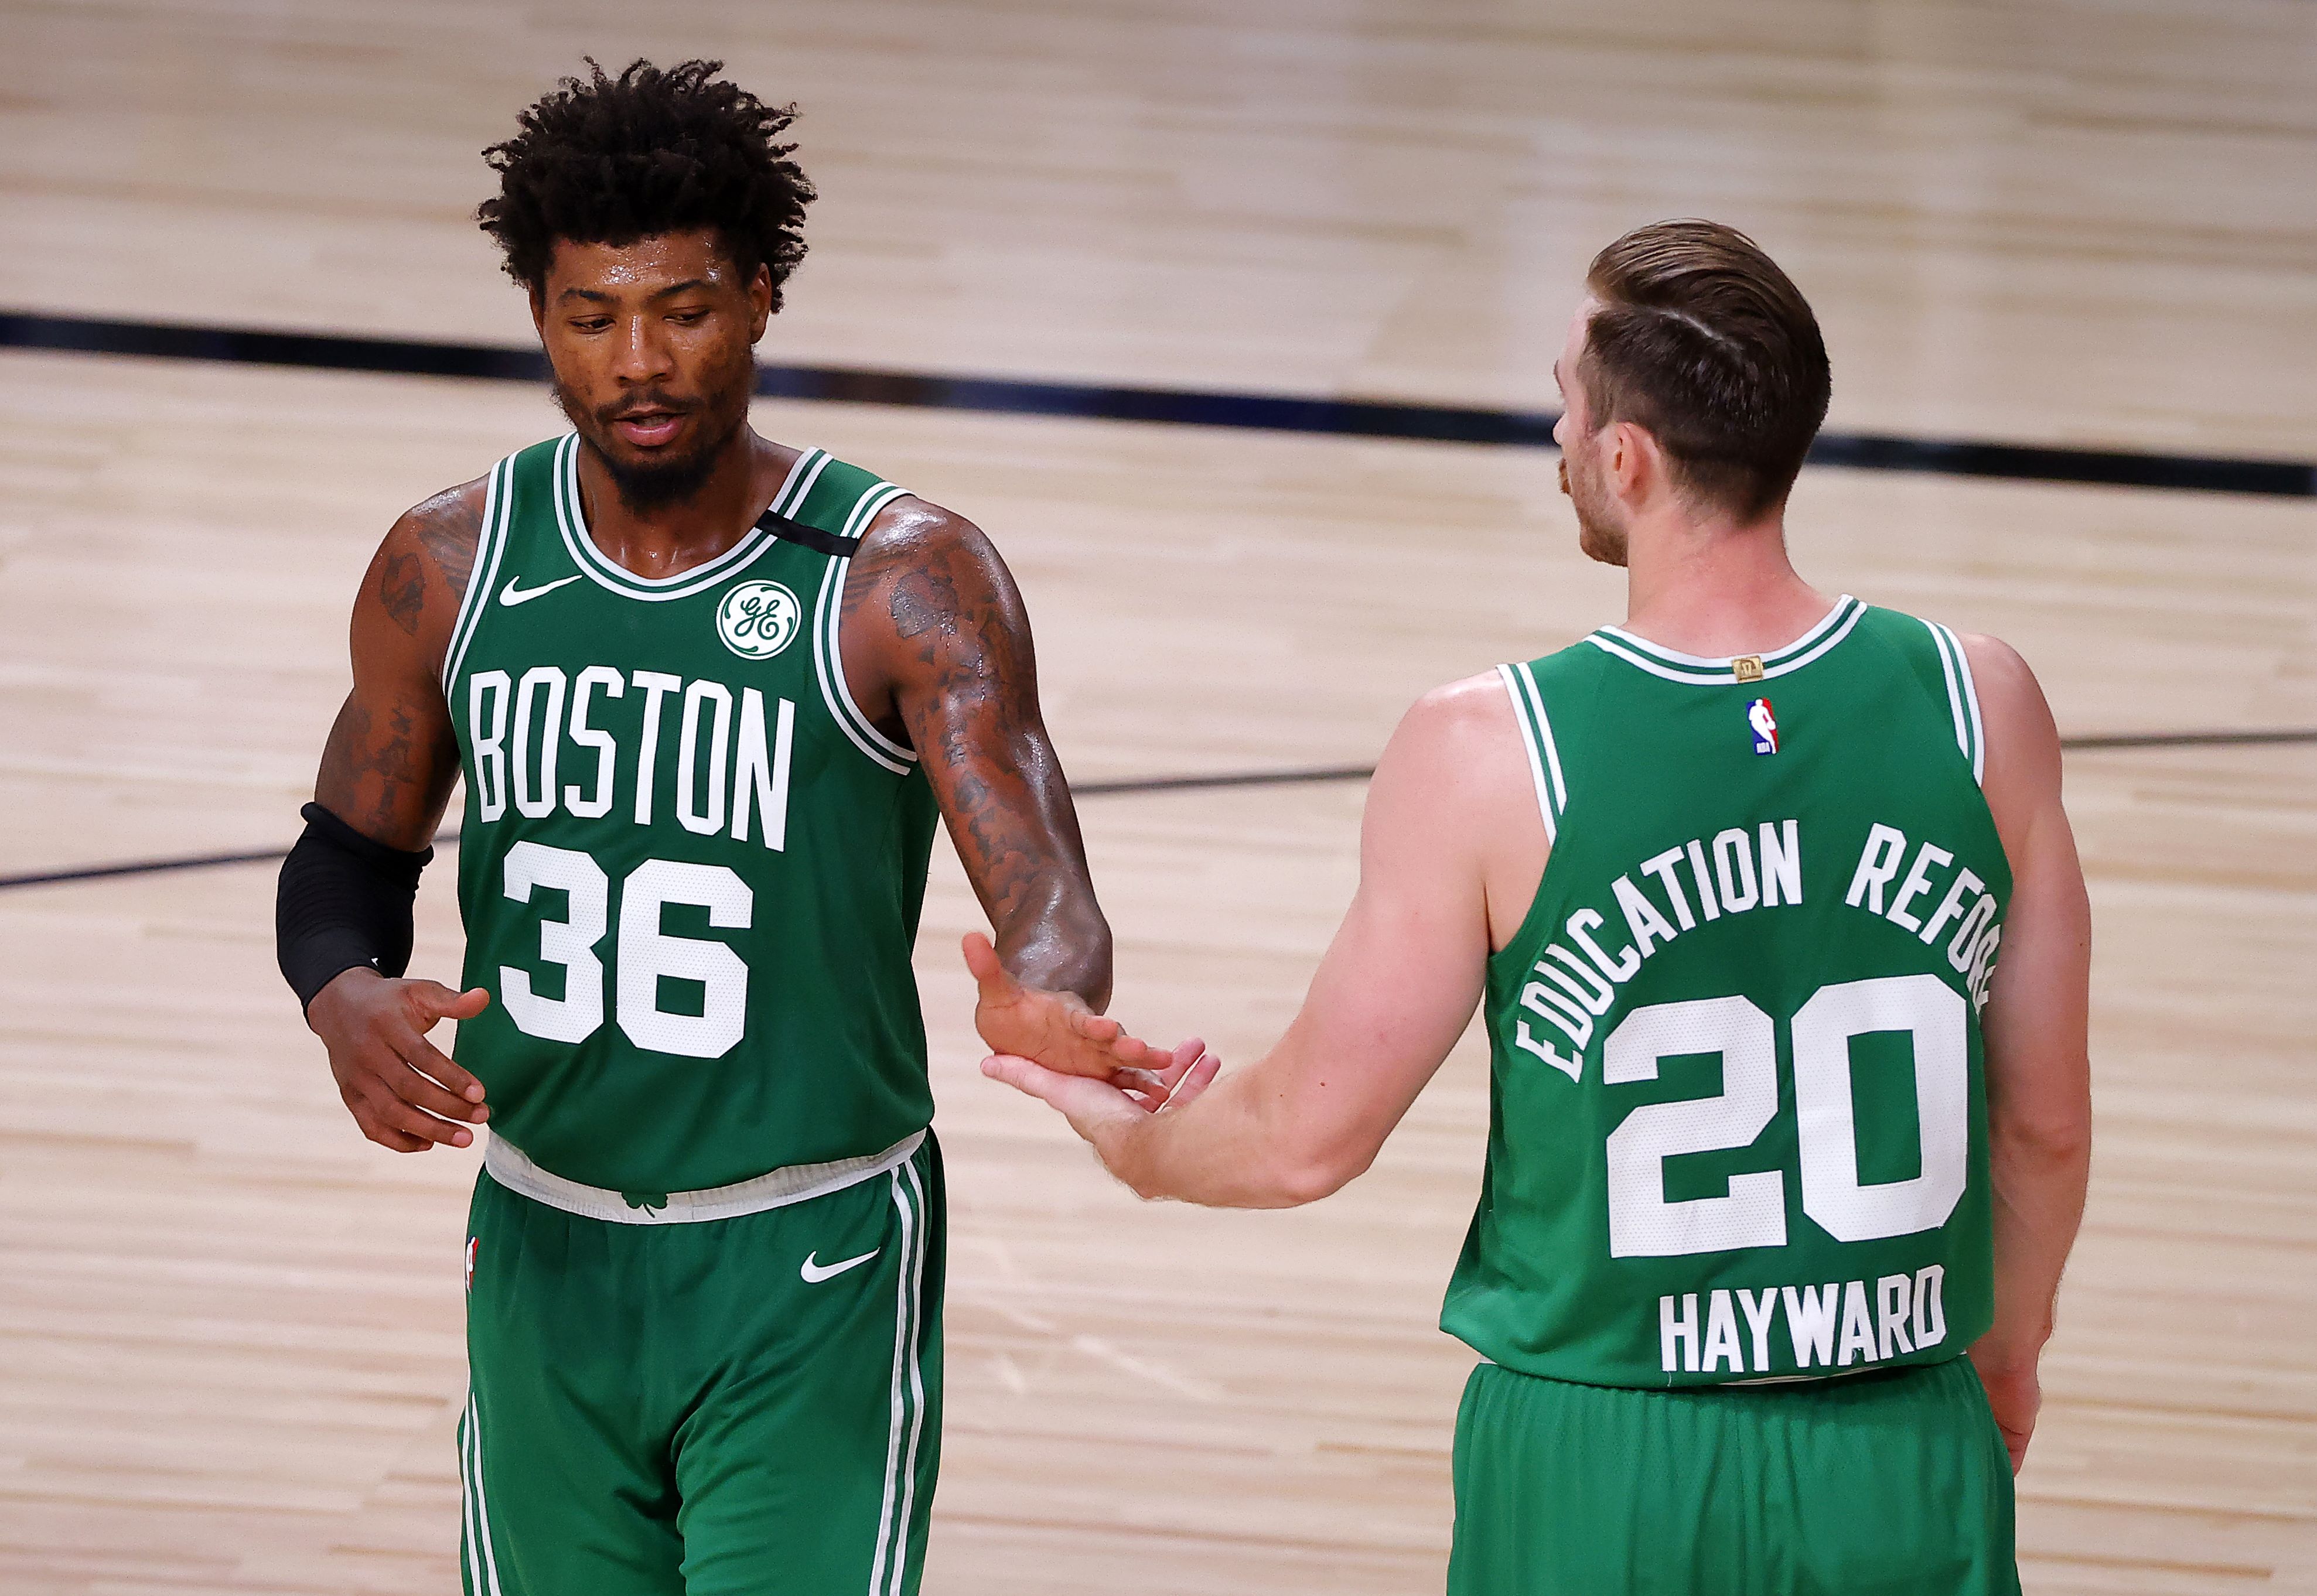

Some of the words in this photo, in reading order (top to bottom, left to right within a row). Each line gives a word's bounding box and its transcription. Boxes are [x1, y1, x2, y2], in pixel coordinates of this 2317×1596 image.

[734, 597, 780, 640] GE
[470, 666, 796, 852] BOSTON
[500, 840, 754, 1058] 36
[1516, 819, 1803, 1083] EDUCATION
[1603, 973, 1968, 1258] 20
[1659, 1263, 1947, 1373] HAYWARD
